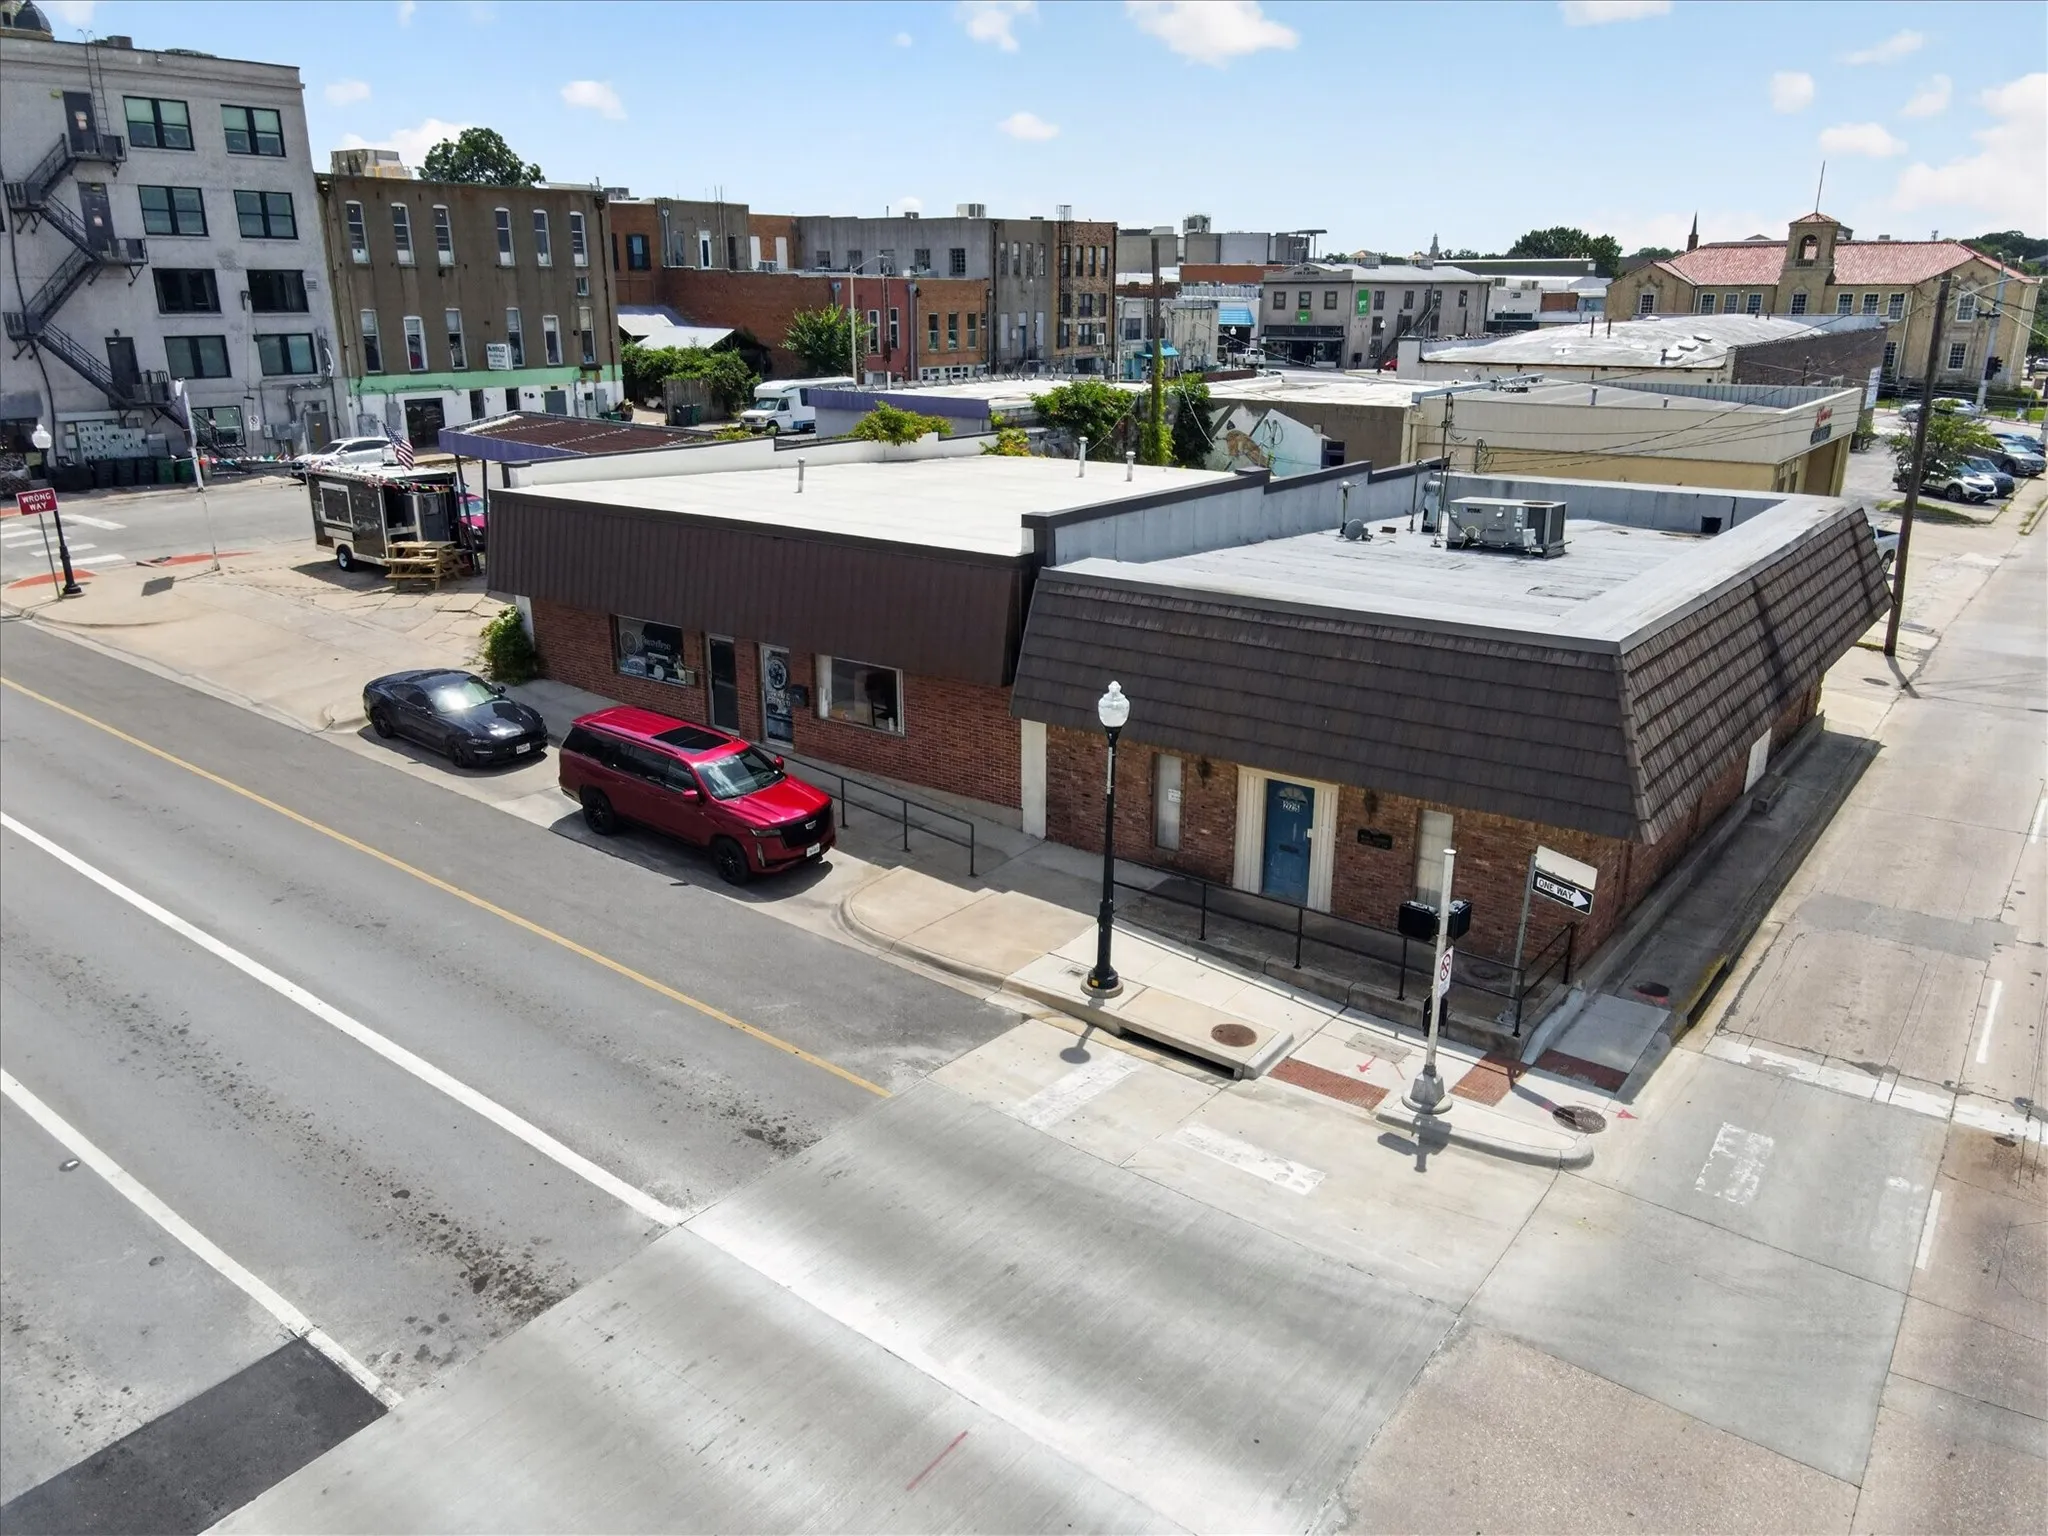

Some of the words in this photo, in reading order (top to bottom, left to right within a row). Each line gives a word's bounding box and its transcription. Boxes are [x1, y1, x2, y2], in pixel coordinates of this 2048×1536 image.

[21, 492, 52, 504] WRONG
[29, 501, 48, 511] WAY
[1538, 879, 1555, 892] ONE
[1556, 886, 1574, 900] WAY
